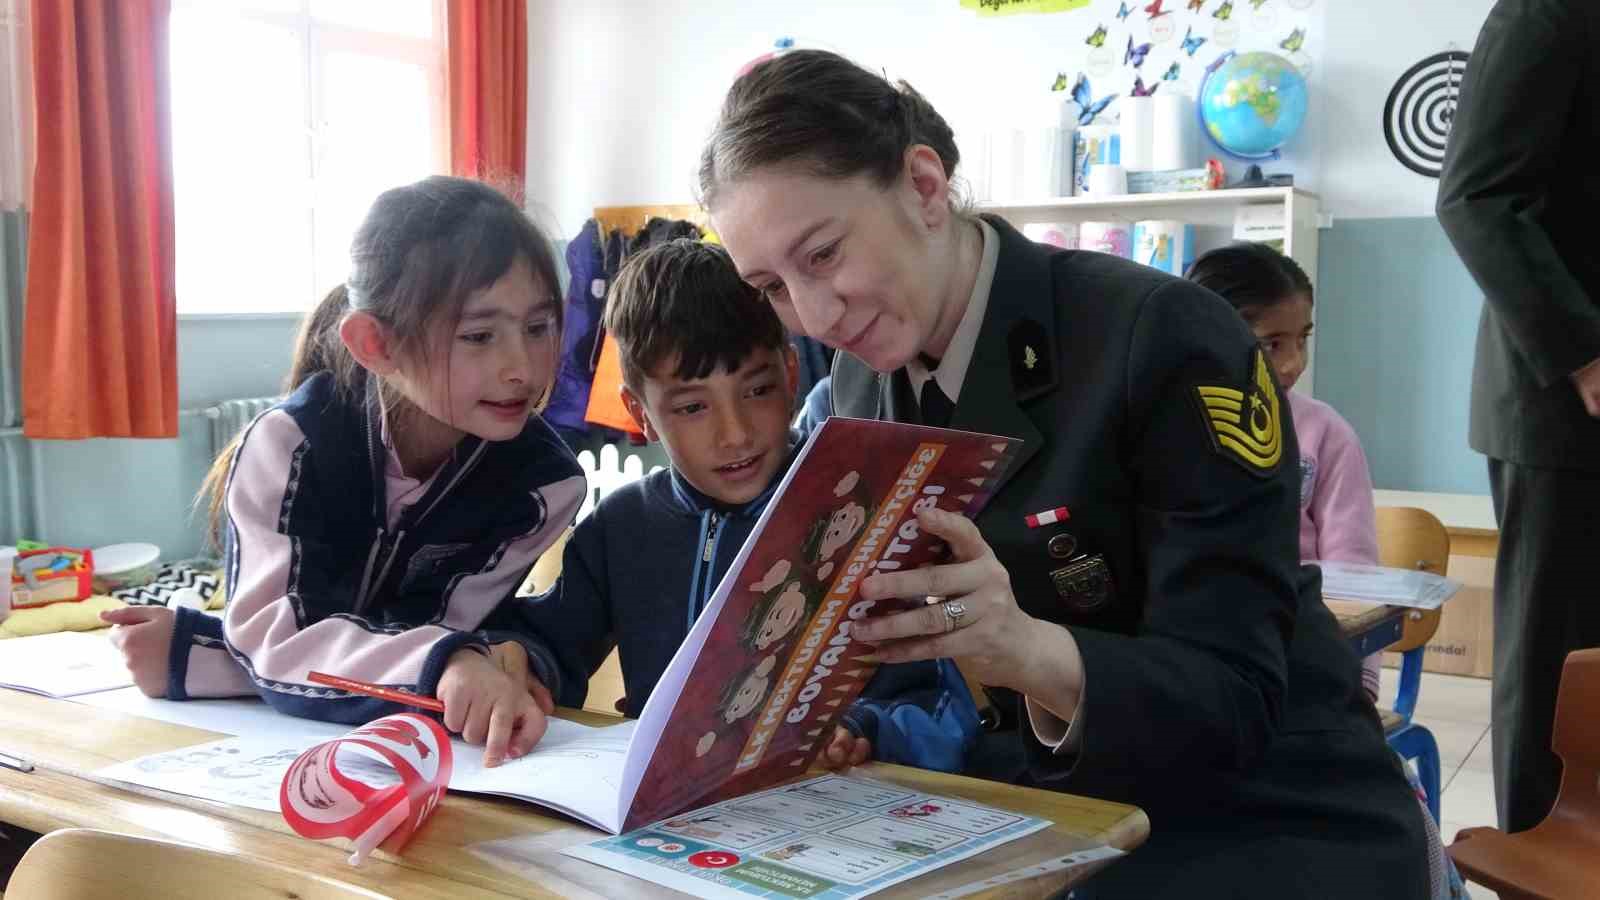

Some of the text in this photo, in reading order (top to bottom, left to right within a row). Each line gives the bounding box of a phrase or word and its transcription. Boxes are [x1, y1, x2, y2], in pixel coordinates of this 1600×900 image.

[735, 731, 769, 769] İLK
[762, 600, 843, 726] MEKTUBUM
[834, 448, 937, 594] MEHMETÇİĞE
[786, 599, 877, 724] BOYAMA
[867, 484, 946, 578] İTABI
